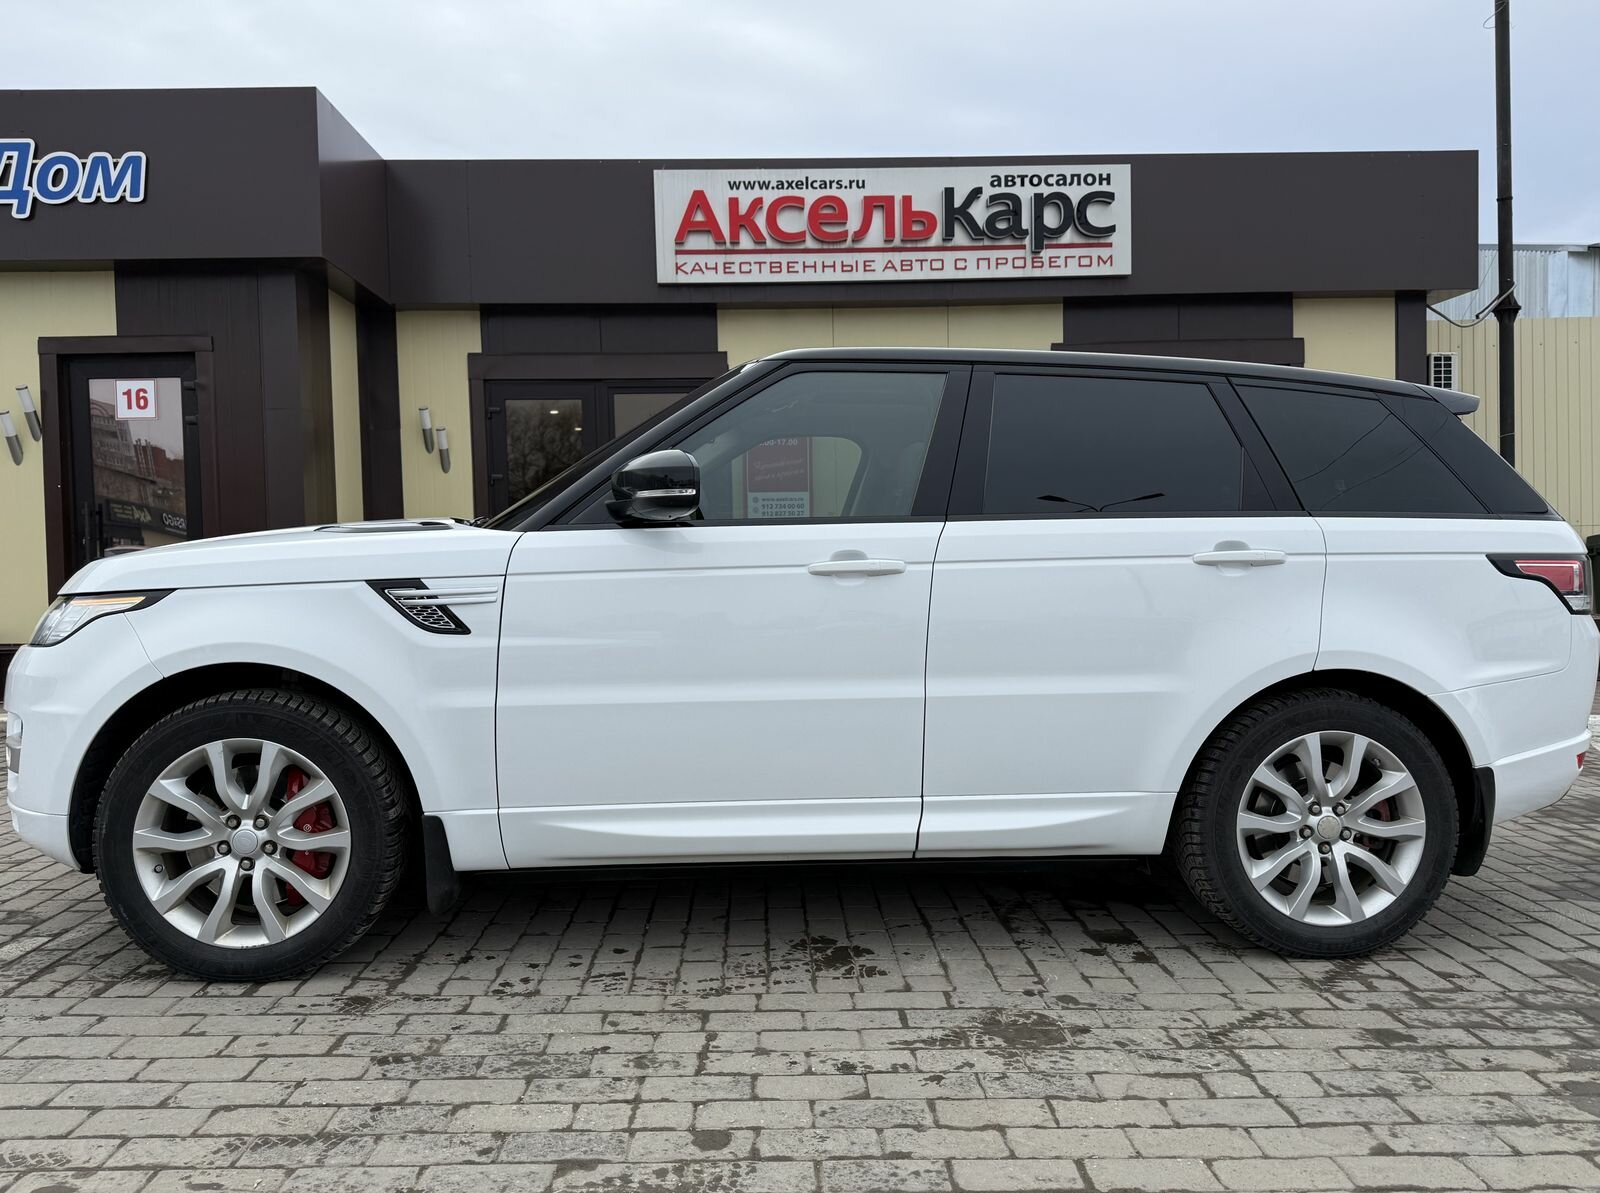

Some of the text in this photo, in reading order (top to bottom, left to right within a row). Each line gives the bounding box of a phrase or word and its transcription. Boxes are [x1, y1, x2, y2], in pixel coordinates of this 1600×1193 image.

[727, 176, 866, 191] www.axelcars.ru
[989, 172, 1111, 188] автосалон
[674, 253, 1114, 275] КАЧЕСТВЕННЫЕ АВТО С ПРОБЕГОМ
[122, 388, 149, 410] 16
